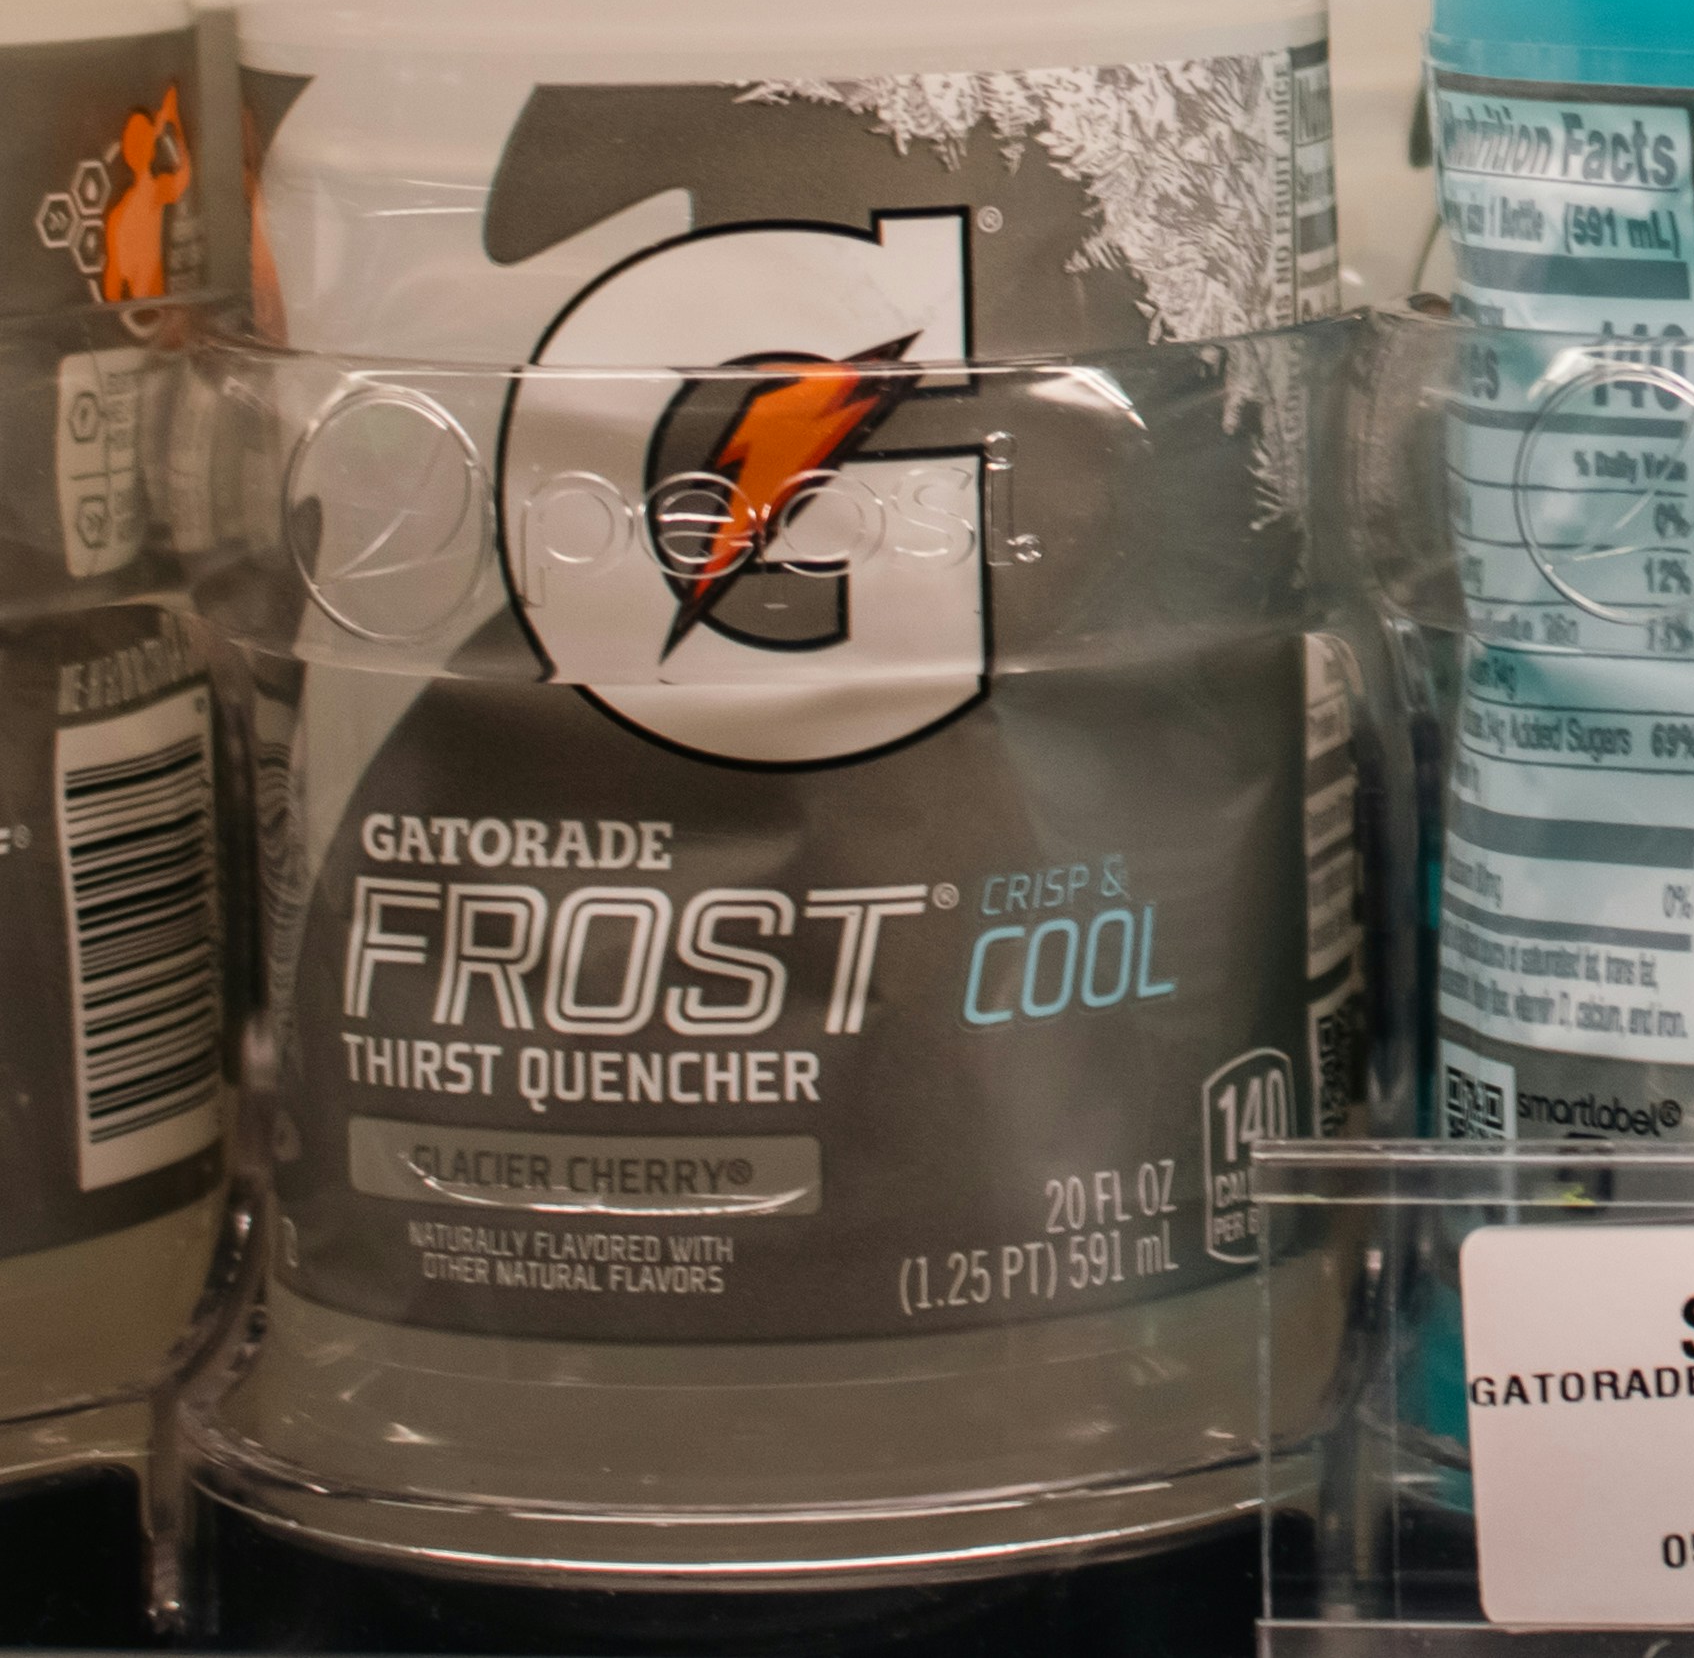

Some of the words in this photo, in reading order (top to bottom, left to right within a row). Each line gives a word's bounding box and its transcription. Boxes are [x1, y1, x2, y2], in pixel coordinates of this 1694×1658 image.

[1561, 112, 1678, 187] Facts
[1563, 203, 1620, 256] (591
[361, 812, 675, 872] GATORADE
[980, 862, 1090, 917] CRISP
[1100, 853, 1133, 900] &
[962, 904, 1178, 1028] COOL
[341, 1031, 504, 1097] THIRST
[518, 1045, 822, 1113] QUENCHER
[1216, 1066, 1289, 1163] 140
[411, 1144, 554, 1195] GLACIER
[1044, 1174, 1087, 1235] 20
[1097, 1168, 1133, 1226] FL
[1136, 1158, 1178, 1216] OZ
[407, 1218, 529, 1259] NATURALLY
[532, 1229, 662, 1264] FLAVORED
[667, 1235, 735, 1265] WITH
[421, 1248, 491, 1286] OTHER
[496, 1253, 605, 1293] NATURAL
[608, 1257, 727, 1296] FLAVORS
[899, 1247, 992, 1316] (1.25
[1000, 1238, 1059, 1300] PT)
[1067, 1228, 1126, 1290] 591
[1134, 1219, 1179, 1276] mL
